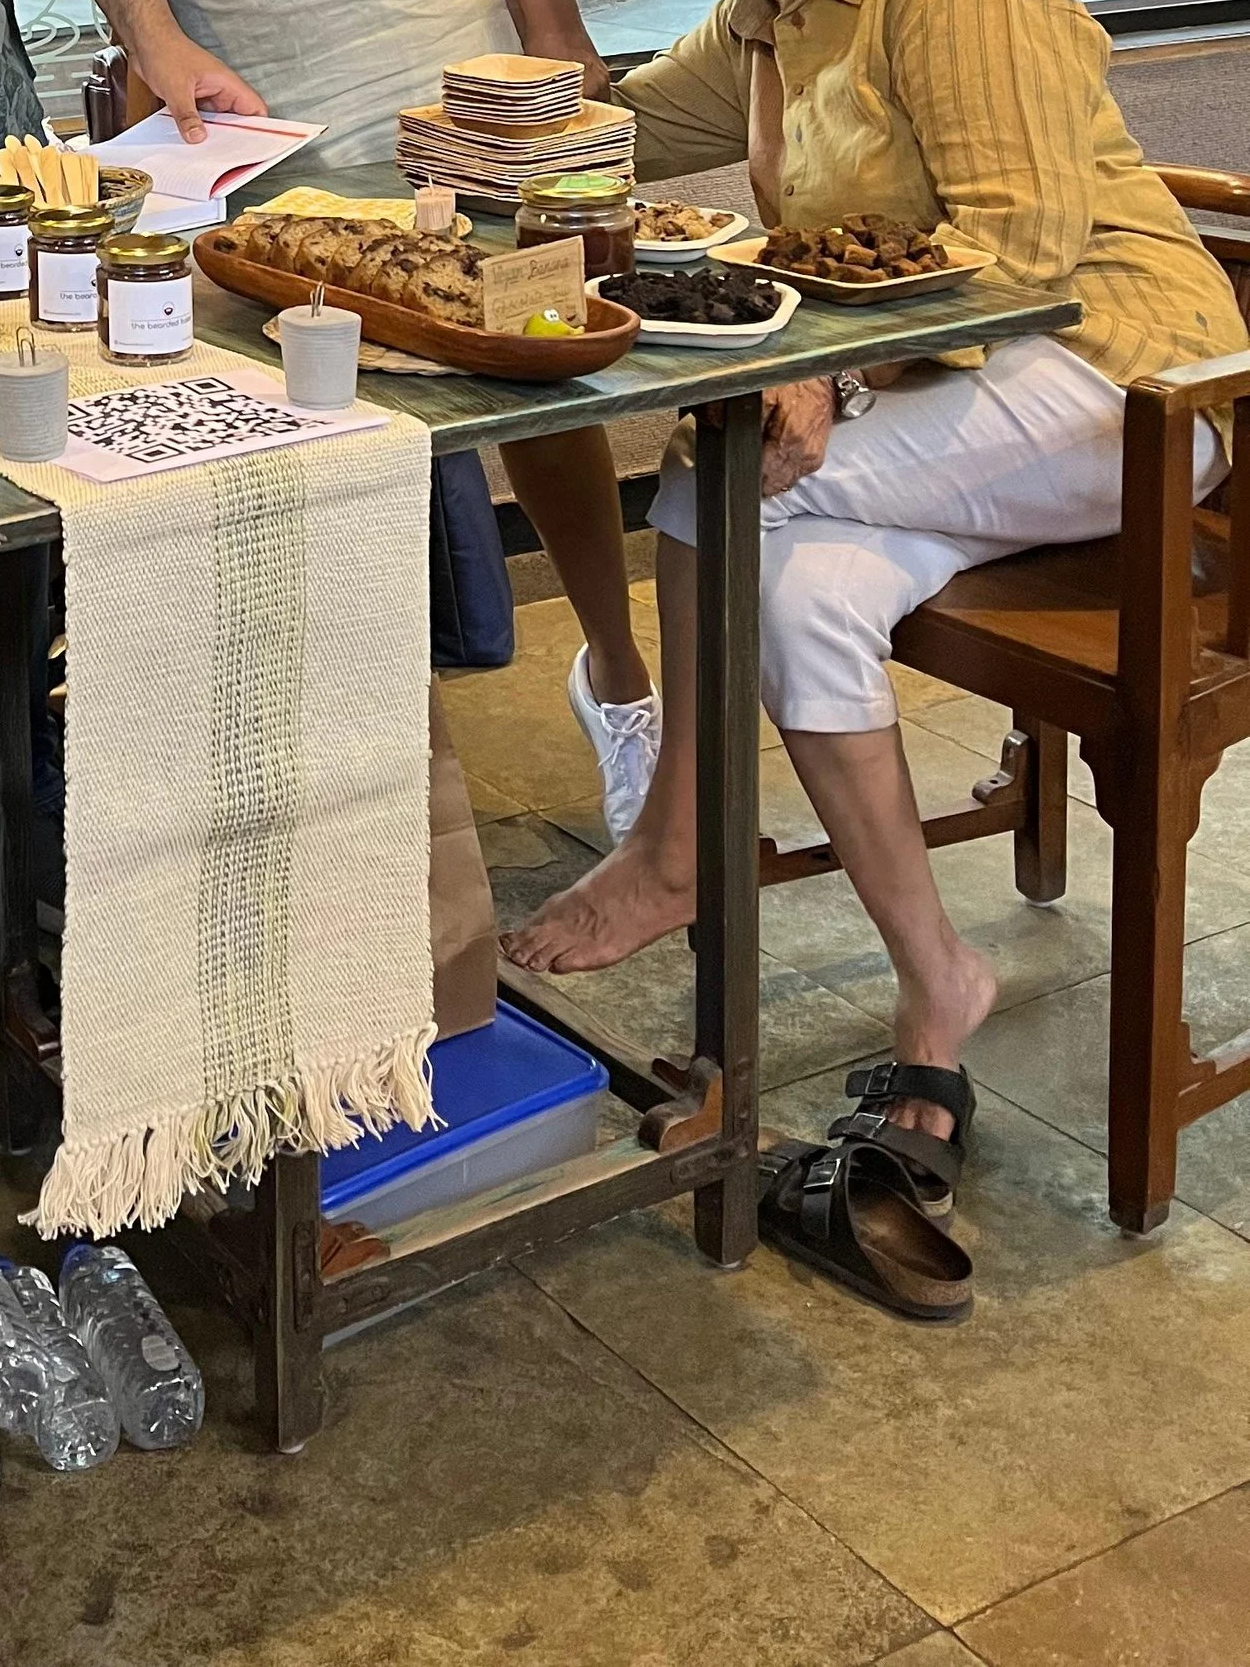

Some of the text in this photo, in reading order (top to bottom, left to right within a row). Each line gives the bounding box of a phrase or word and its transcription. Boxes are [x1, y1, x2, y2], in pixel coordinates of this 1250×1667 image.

[59, 292, 73, 301] the
[131, 322, 145, 330] the
[147, 318, 179, 331] bearded
